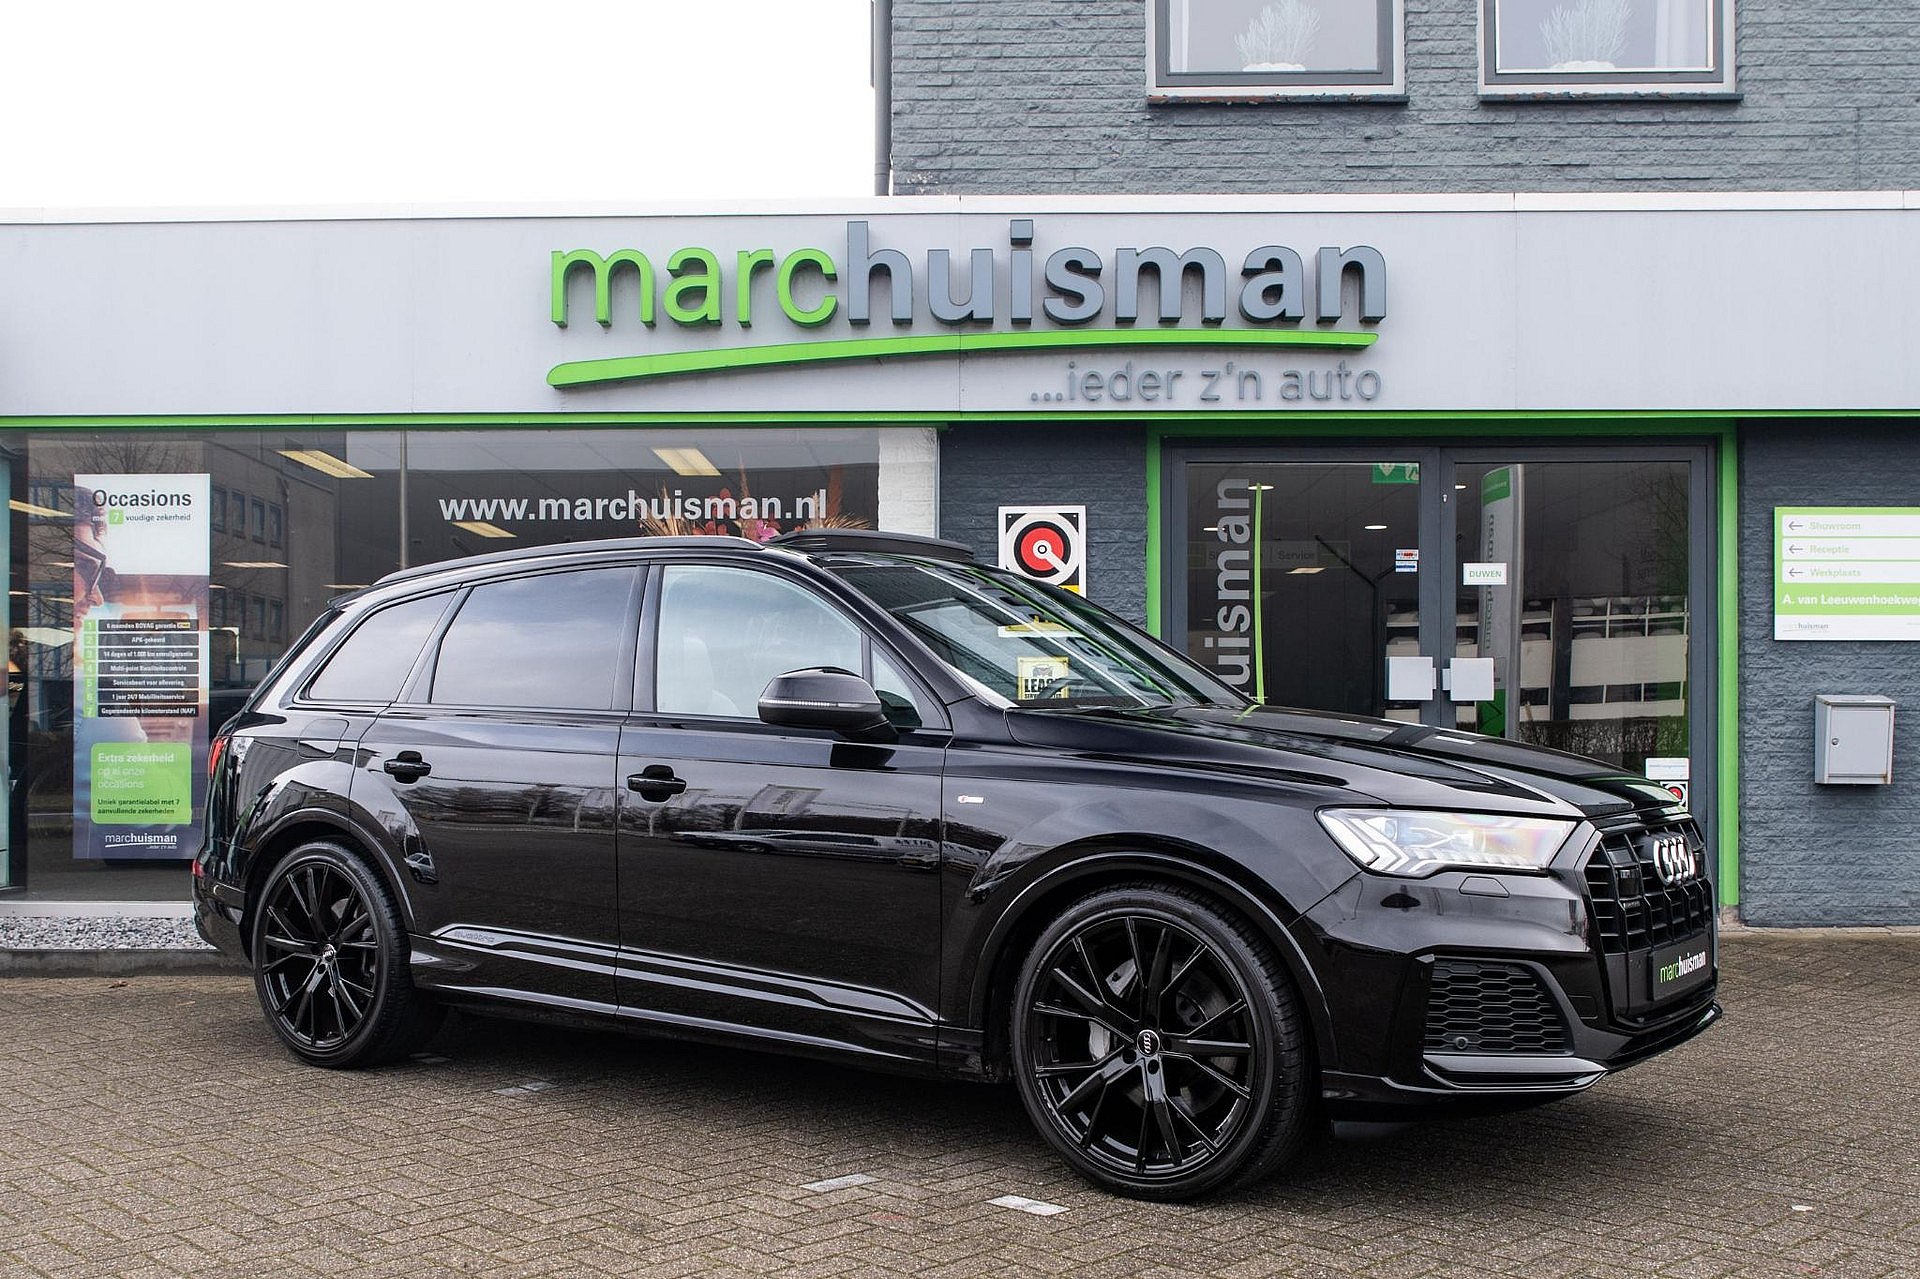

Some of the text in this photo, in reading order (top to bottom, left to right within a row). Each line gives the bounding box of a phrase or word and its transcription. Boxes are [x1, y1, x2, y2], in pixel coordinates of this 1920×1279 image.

[551, 219, 1387, 328] marchuisman
[1201, 361, 1262, 402] z'n
[1281, 361, 1382, 402] auto
[92, 489, 192, 507] Occasions
[438, 489, 827, 520] www.marchuisman.nl
[126, 513, 154, 522] voudige
[156, 513, 191, 521] zekerheid
[1469, 570, 1502, 578] DUWEN
[1204, 478, 1251, 698] uisman
[1798, 596, 1818, 605] van
[1821, 594, 1920, 606] Leeuwenhoekwe
[1024, 678, 1056, 692] LEA
[98, 753, 124, 762] Extra
[105, 833, 177, 842] marchuisman
[1660, 951, 1706, 983] marchuisman
